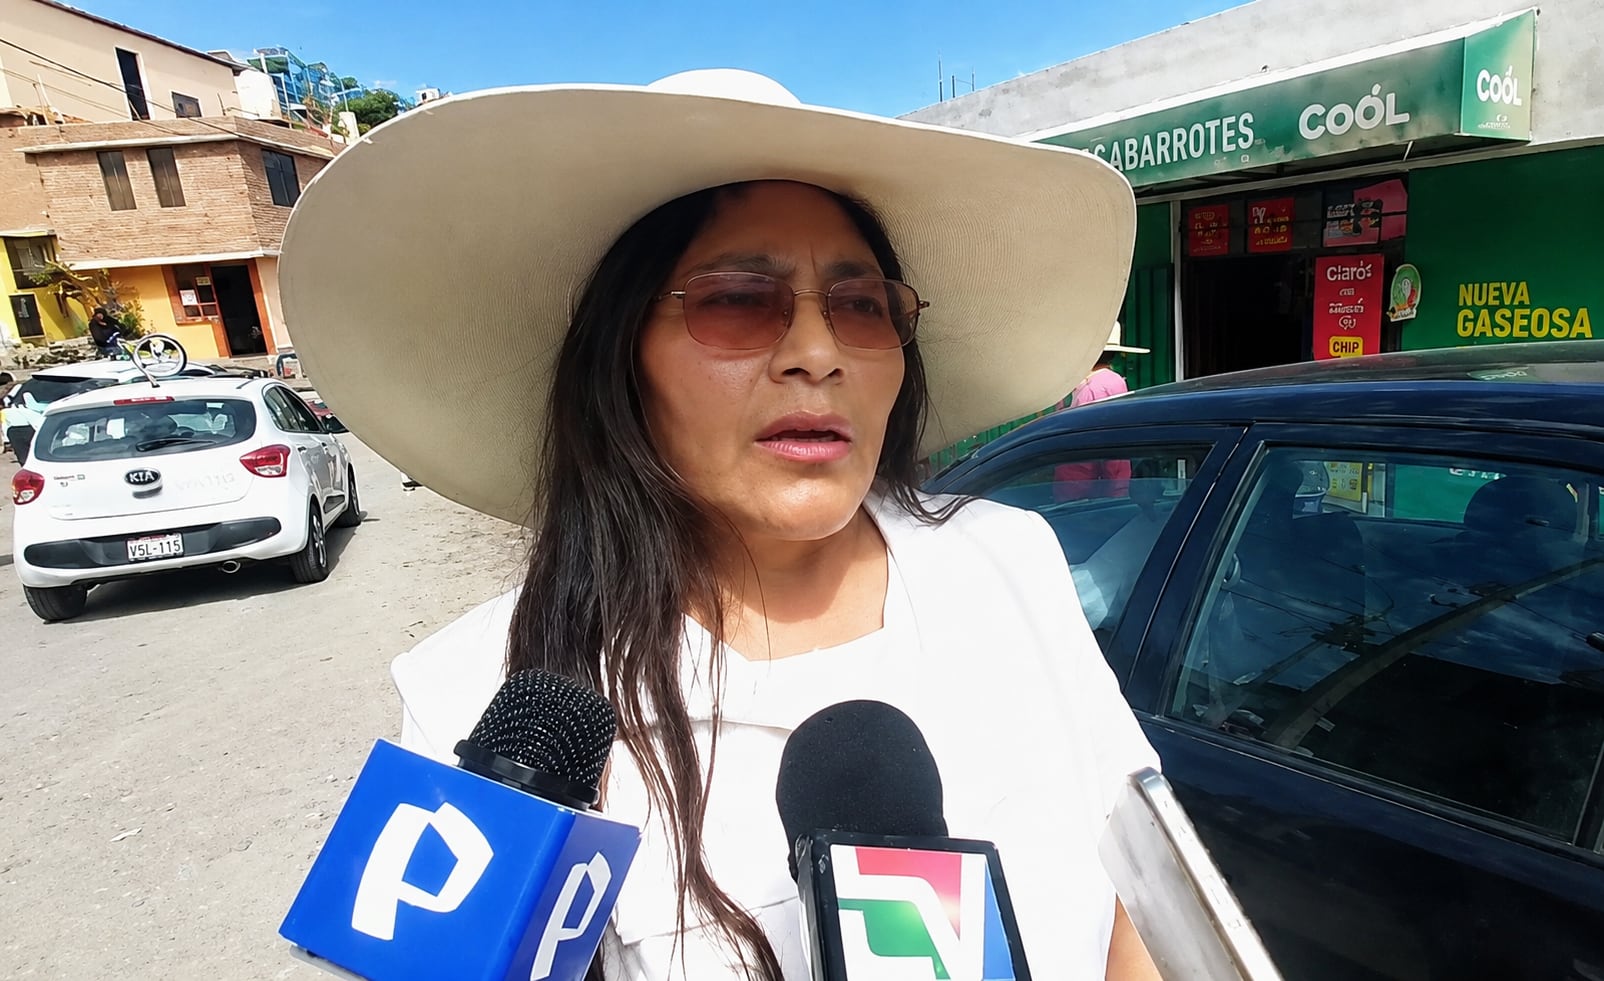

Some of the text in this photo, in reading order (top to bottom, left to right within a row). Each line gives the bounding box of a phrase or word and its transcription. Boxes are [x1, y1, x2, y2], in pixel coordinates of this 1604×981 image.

[1458, 281, 1530, 306] NUEVA
[1457, 307, 1593, 338] GASEOSA
[1333, 341, 1359, 353] CHIP
[129, 471, 155, 482] KIA
[129, 539, 181, 557] V5L-115
